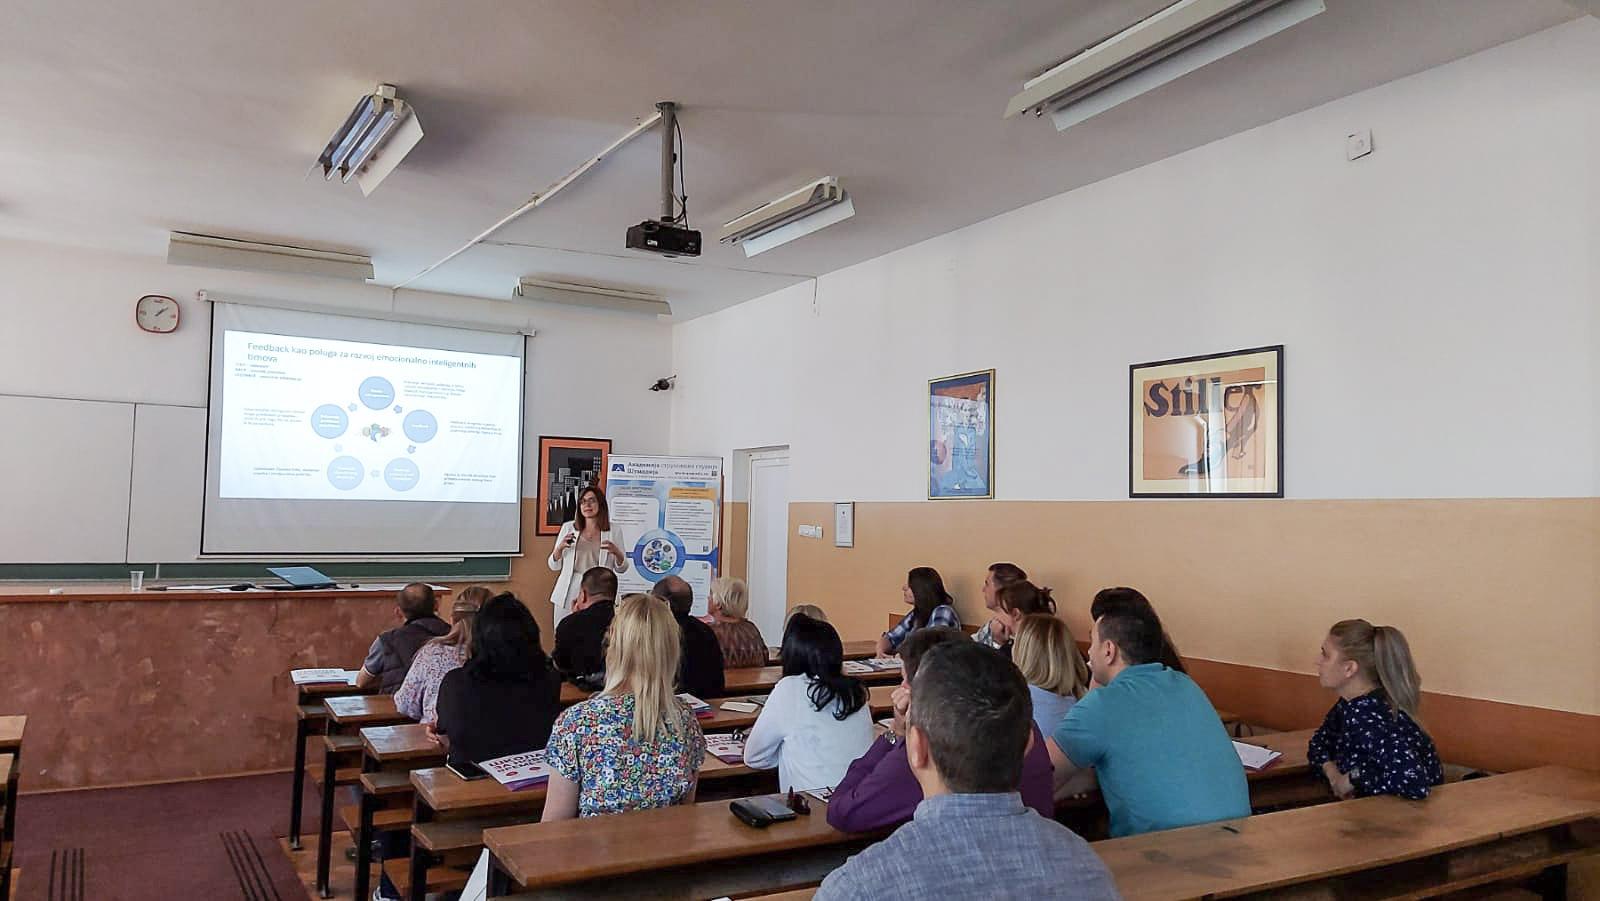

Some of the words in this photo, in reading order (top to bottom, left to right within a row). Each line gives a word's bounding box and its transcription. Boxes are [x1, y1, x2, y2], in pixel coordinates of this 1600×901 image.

[247, 342, 290, 353] Feedback
[309, 348, 337, 359] poluga
[376, 354, 428, 365] emocionalno
